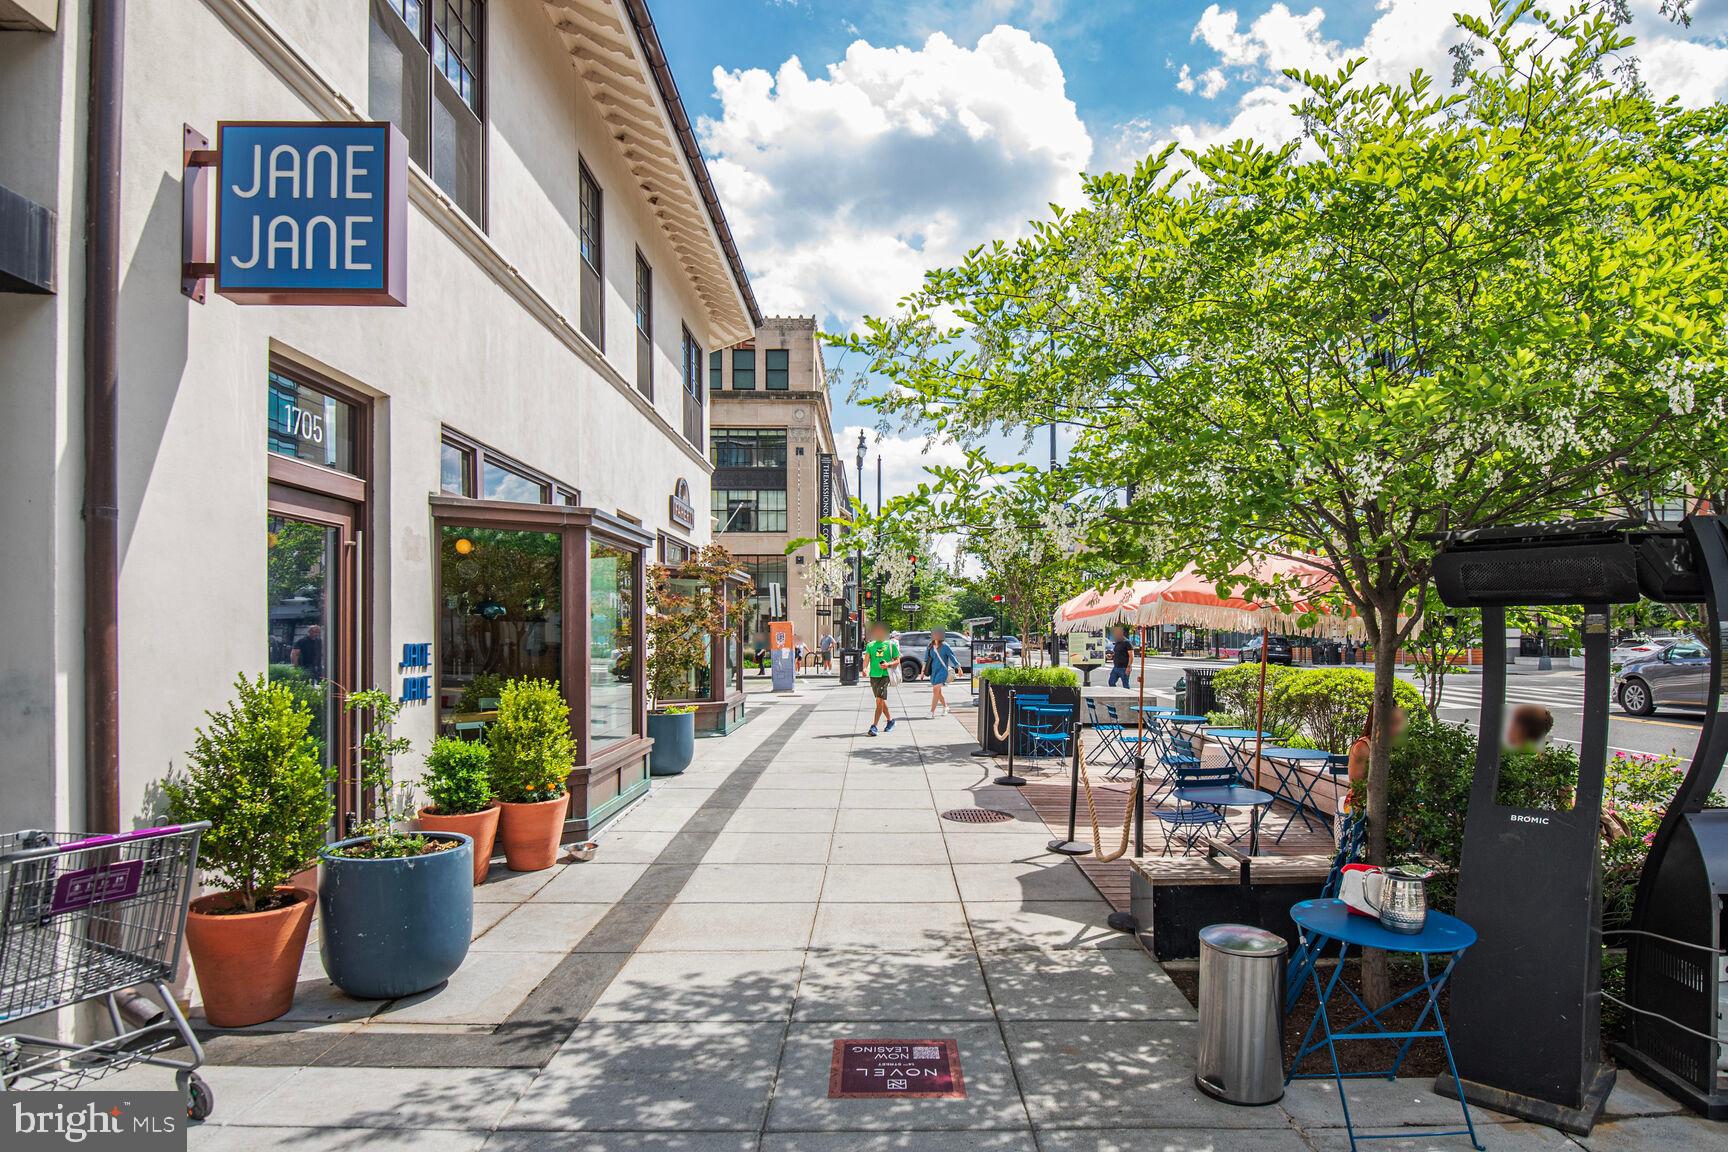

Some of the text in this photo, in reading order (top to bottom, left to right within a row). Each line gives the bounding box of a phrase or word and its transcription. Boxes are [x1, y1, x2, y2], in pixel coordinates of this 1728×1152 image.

[231, 144, 374, 198] JANE
[230, 215, 373, 270] JANE
[285, 404, 323, 443] 1705
[399, 643, 432, 667] JANE
[399, 675, 432, 701] JANE
[1510, 814, 1549, 825] BROMIC
[856, 1068, 938, 1077] NOVEL
